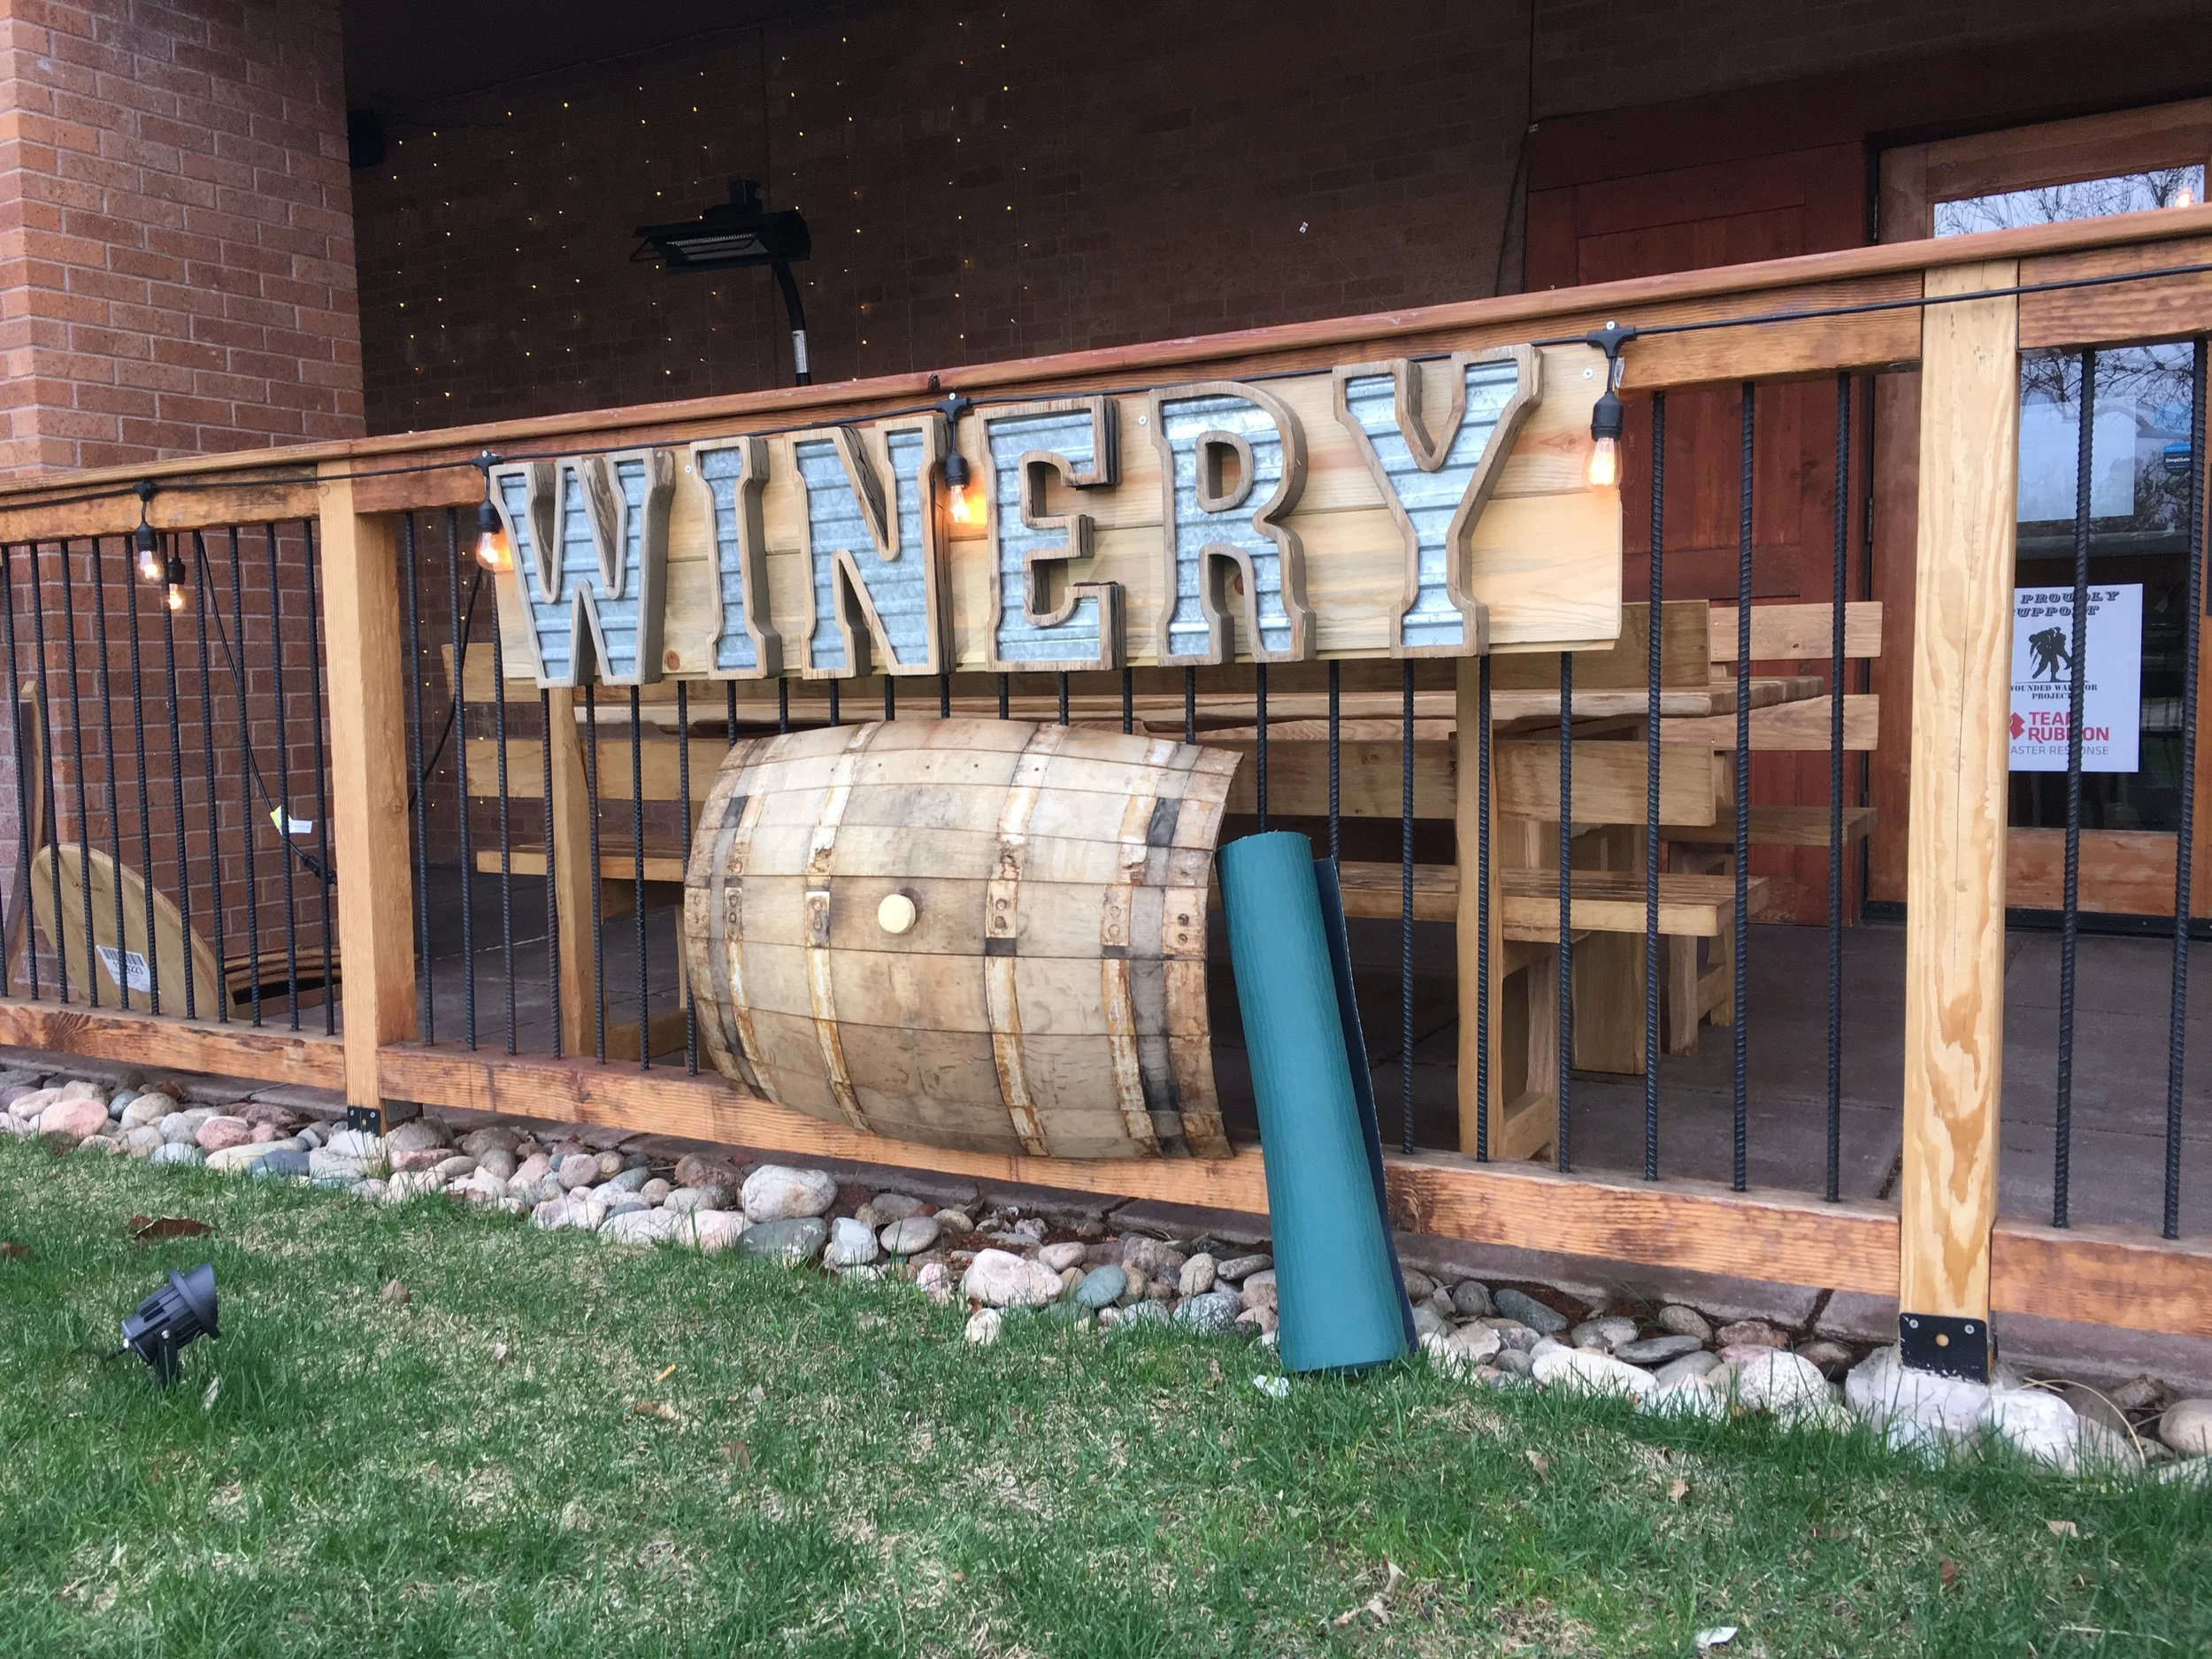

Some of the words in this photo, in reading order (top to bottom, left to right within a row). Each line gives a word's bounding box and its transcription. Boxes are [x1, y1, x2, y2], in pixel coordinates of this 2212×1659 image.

[488, 342, 1544, 689] WINERY
[2014, 605, 2100, 618] UPPOT
[2055, 683, 2098, 692] WAOR
[2028, 726, 2109, 743] RUBION
[2010, 745, 2047, 755] ASTER
[2049, 745, 2109, 756] RESNSE
